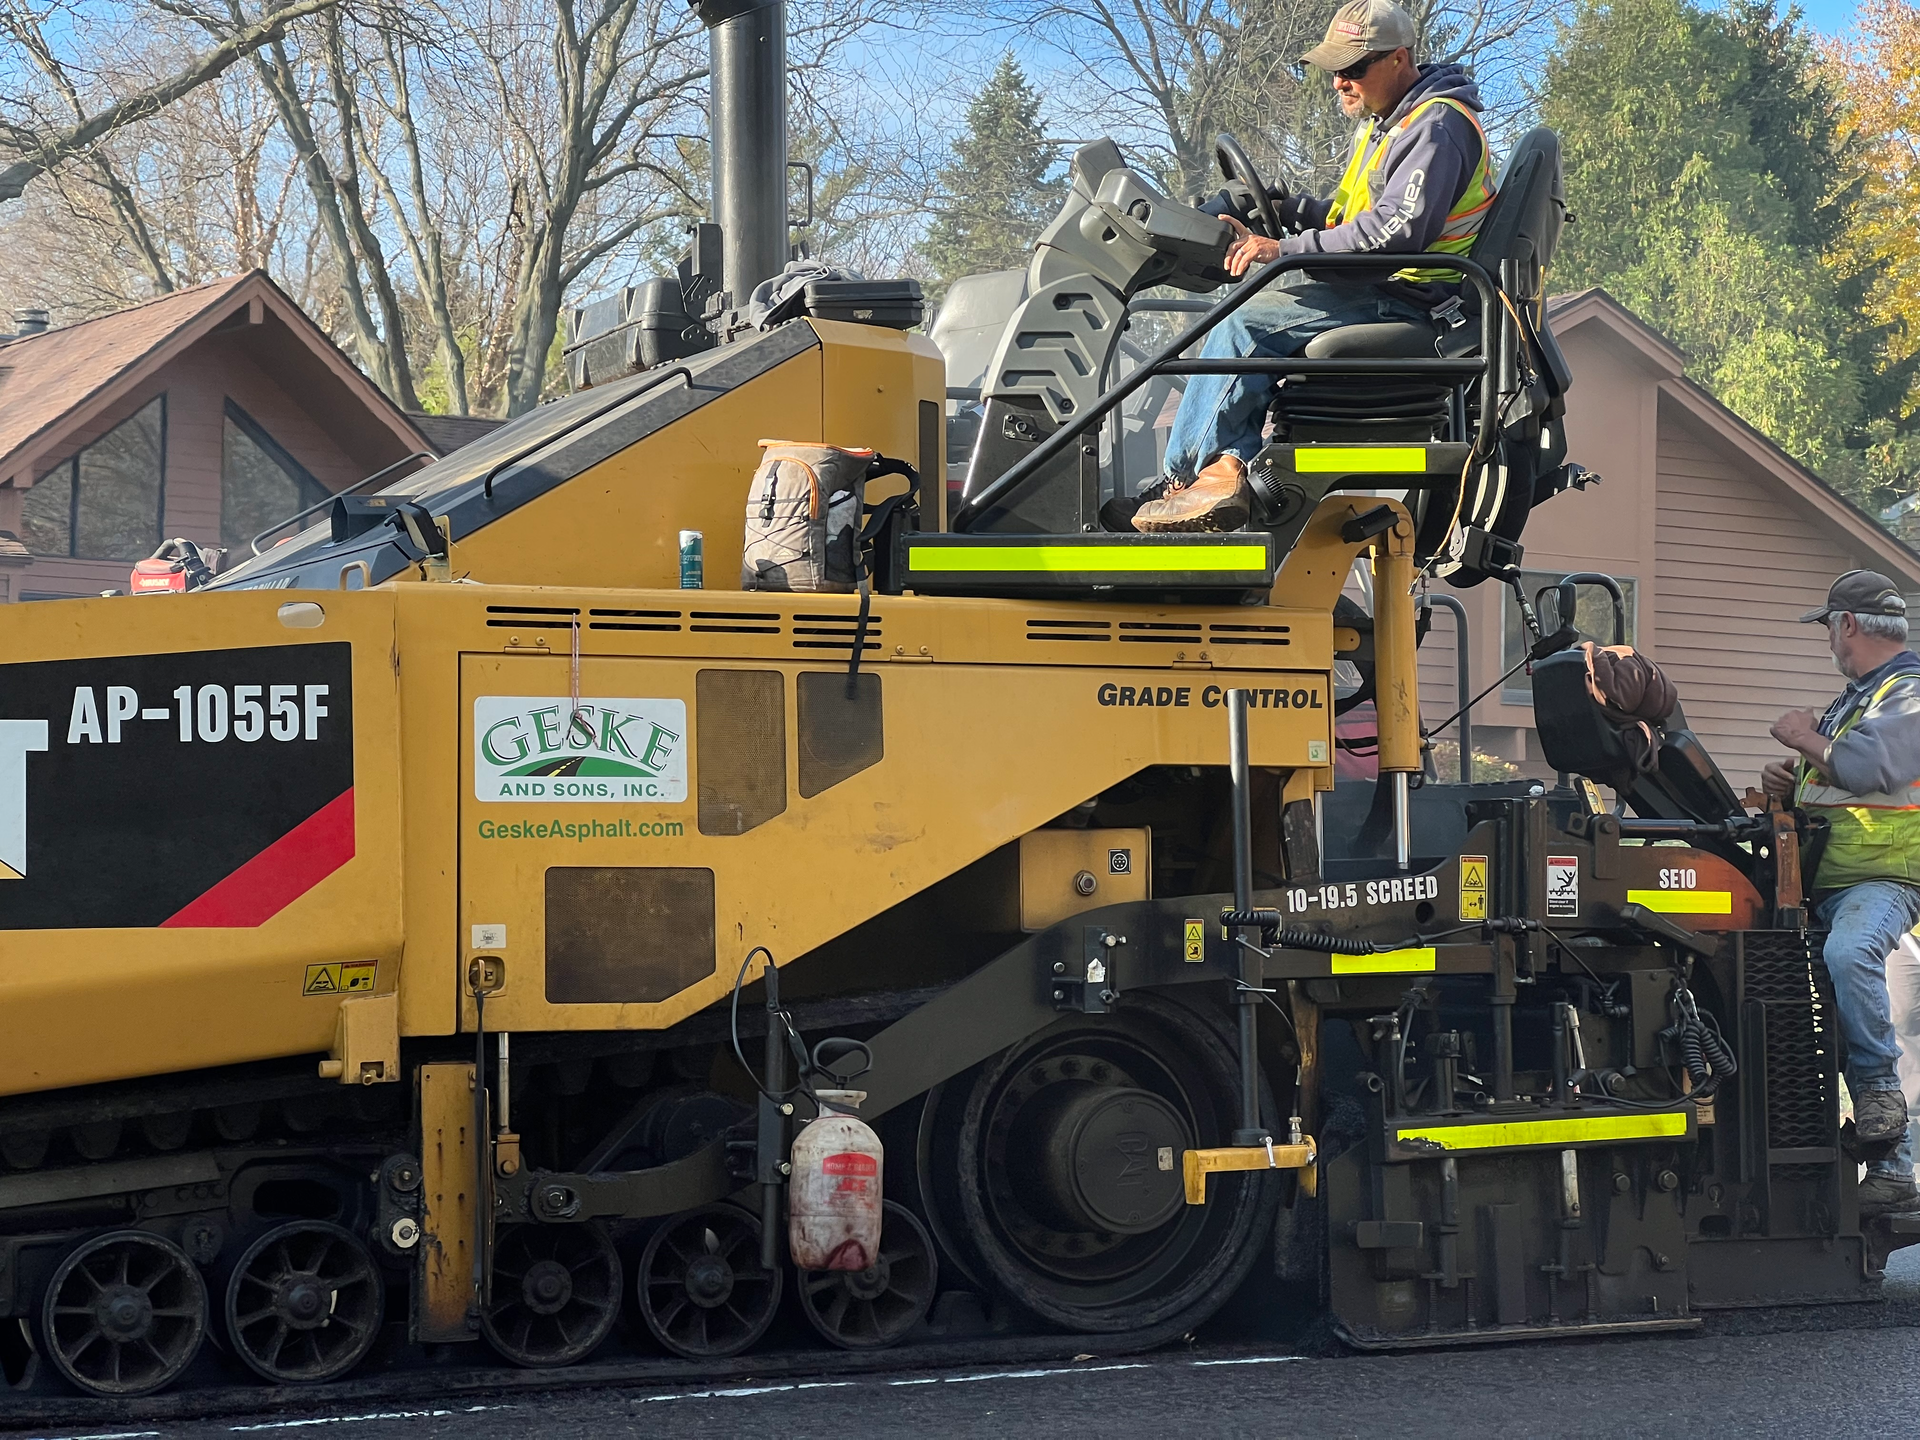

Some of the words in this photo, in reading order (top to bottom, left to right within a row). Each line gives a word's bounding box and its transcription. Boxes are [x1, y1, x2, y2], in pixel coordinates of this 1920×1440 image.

[1359, 168, 1425, 252] carhartt
[1097, 682, 1191, 707] GRADE
[1201, 685, 1323, 709] CNTROL
[66, 684, 330, 744] AP-1055F
[481, 704, 681, 773] GESKE
[499, 783, 545, 797] AND
[553, 783, 615, 799] SONS,
[623, 783, 665, 797] INC.
[478, 818, 685, 843] GeskeAsphalt.com
[1286, 883, 1358, 913] 10-19.5
[1365, 875, 1439, 905] SCREED
[1659, 868, 1697, 889] SE10
